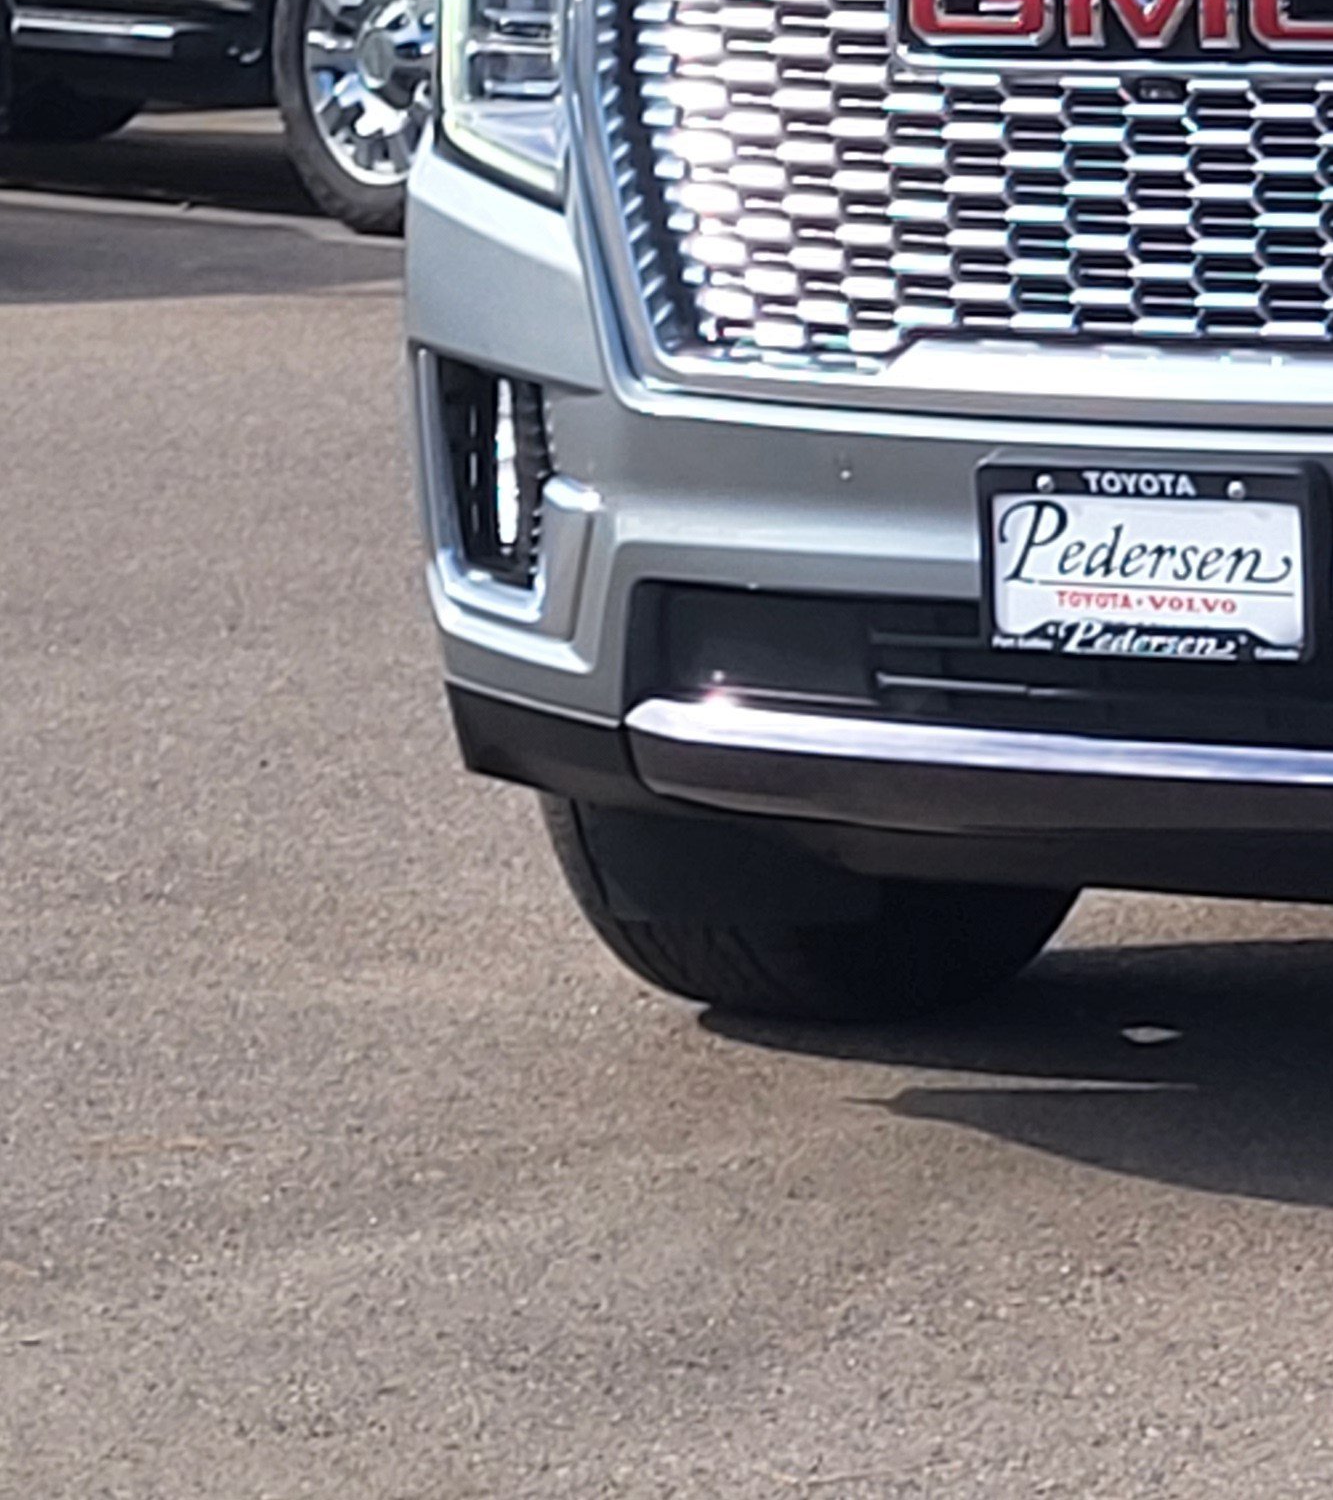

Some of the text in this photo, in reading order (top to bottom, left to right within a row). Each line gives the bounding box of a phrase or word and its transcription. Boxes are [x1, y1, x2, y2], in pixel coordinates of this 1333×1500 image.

[1082, 472, 1197, 497] TOYOTA
[998, 499, 1293, 584] Pedersen
[1056, 590, 1238, 614] TOYOTA VOLVO
[1058, 621, 1237, 658] Pedersen
